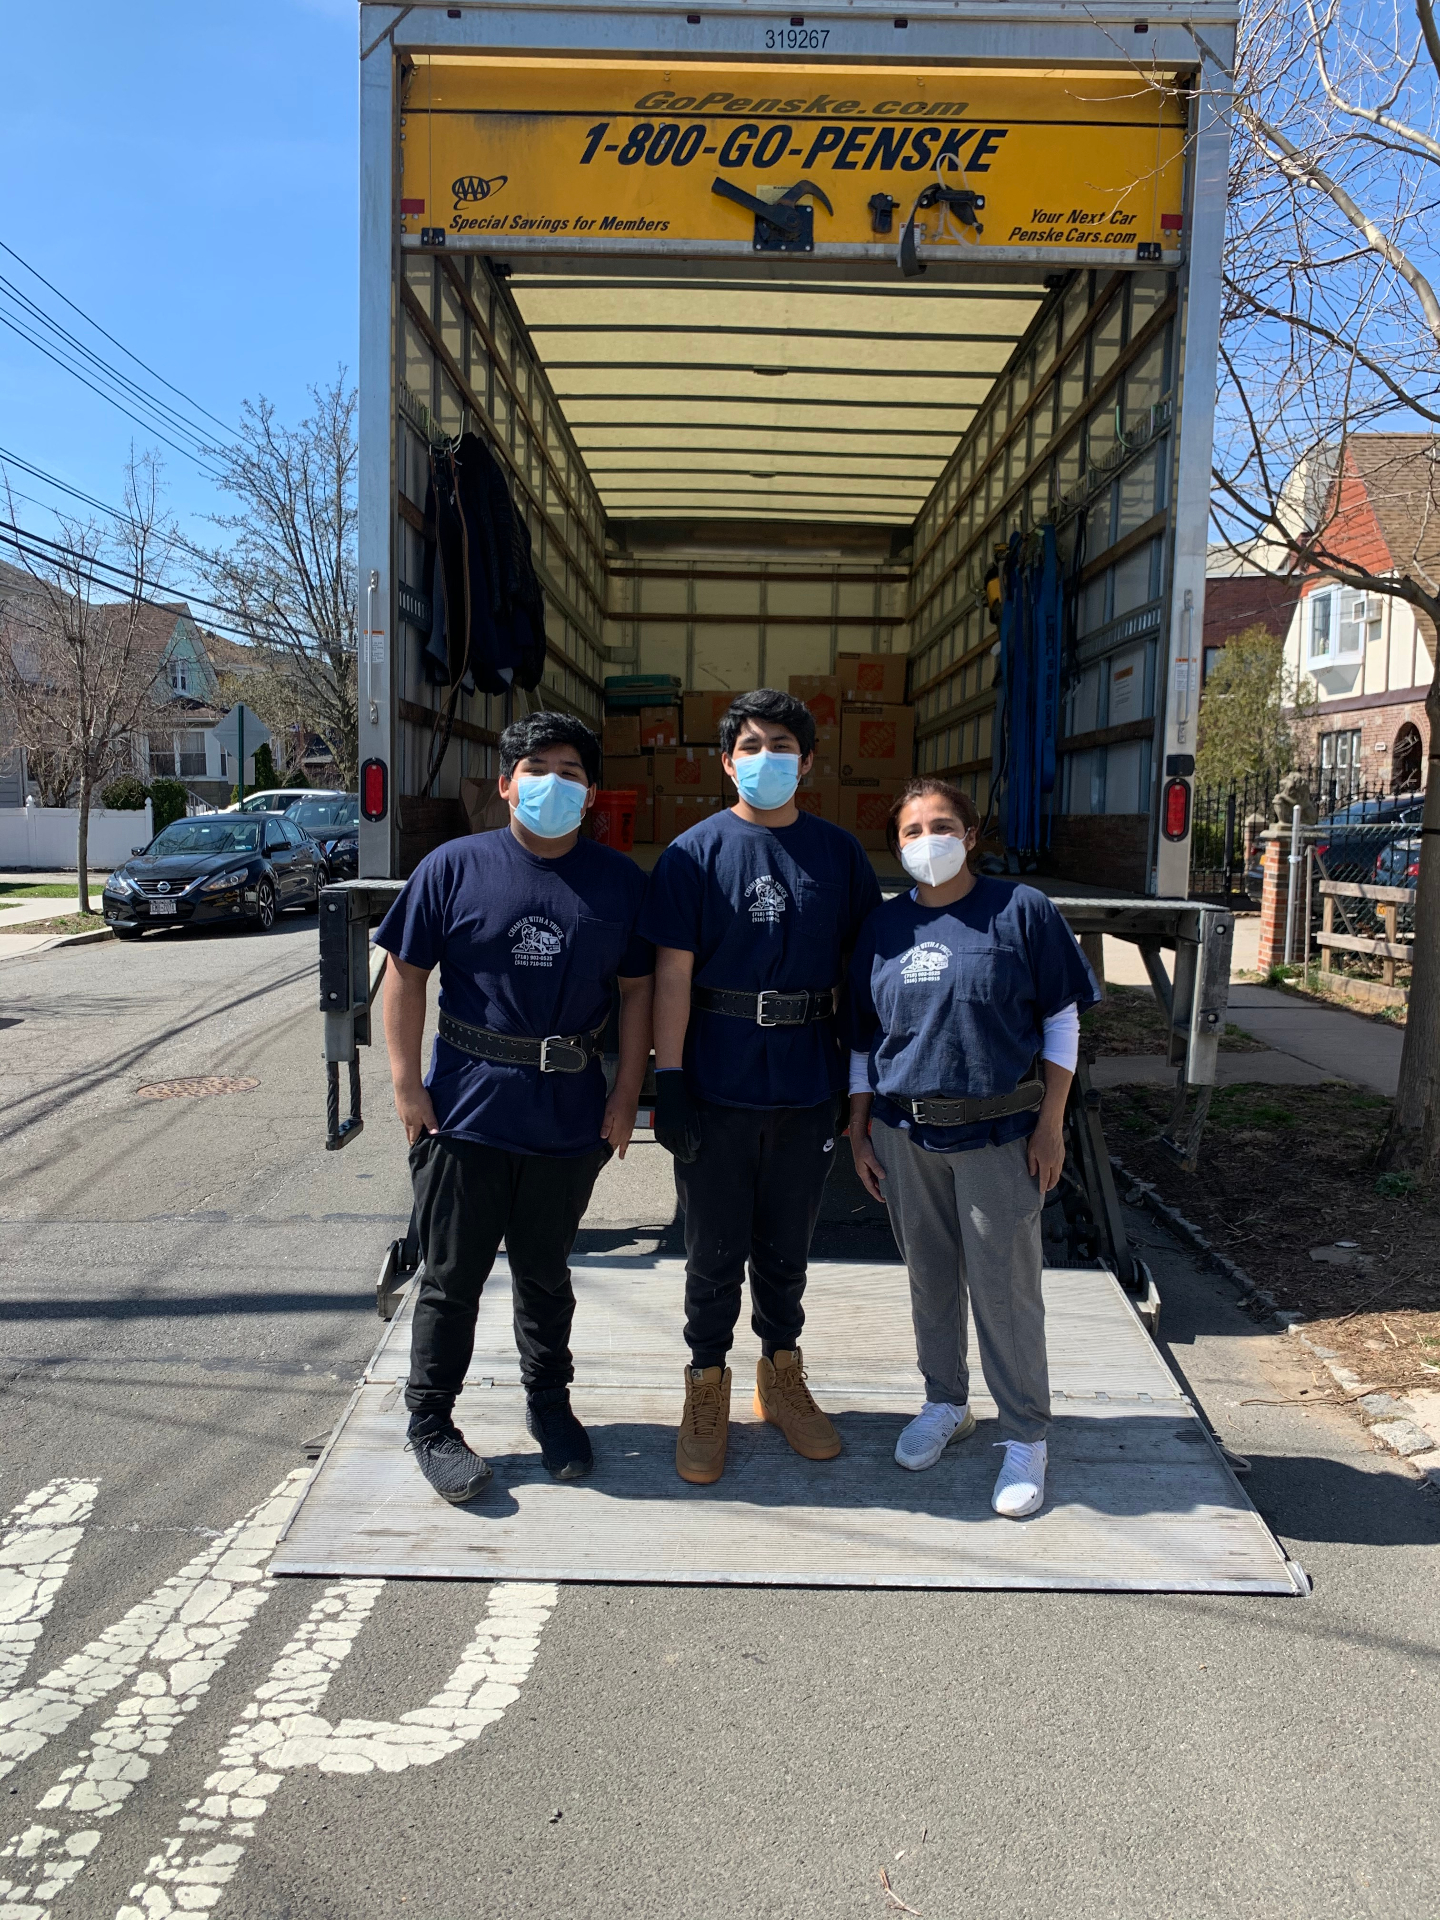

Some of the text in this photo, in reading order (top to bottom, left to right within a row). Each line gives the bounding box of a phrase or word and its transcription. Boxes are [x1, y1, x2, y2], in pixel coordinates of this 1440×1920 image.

[765, 29, 831, 49] 319267
[633, 90, 971, 117] GoPenske.com
[579, 122, 1009, 173] 1-800-GO-PENSKE
[456, 177, 490, 201] AAA
[450, 214, 671, 233] Special Savings for Members
[1030, 209, 1138, 225] Your Next Car
[774, 881, 789, 899] TRUCK
[507, 917, 530, 938] CHARLIE
[549, 920, 565, 940] TRUCK
[919, 941, 936, 950] WITH
